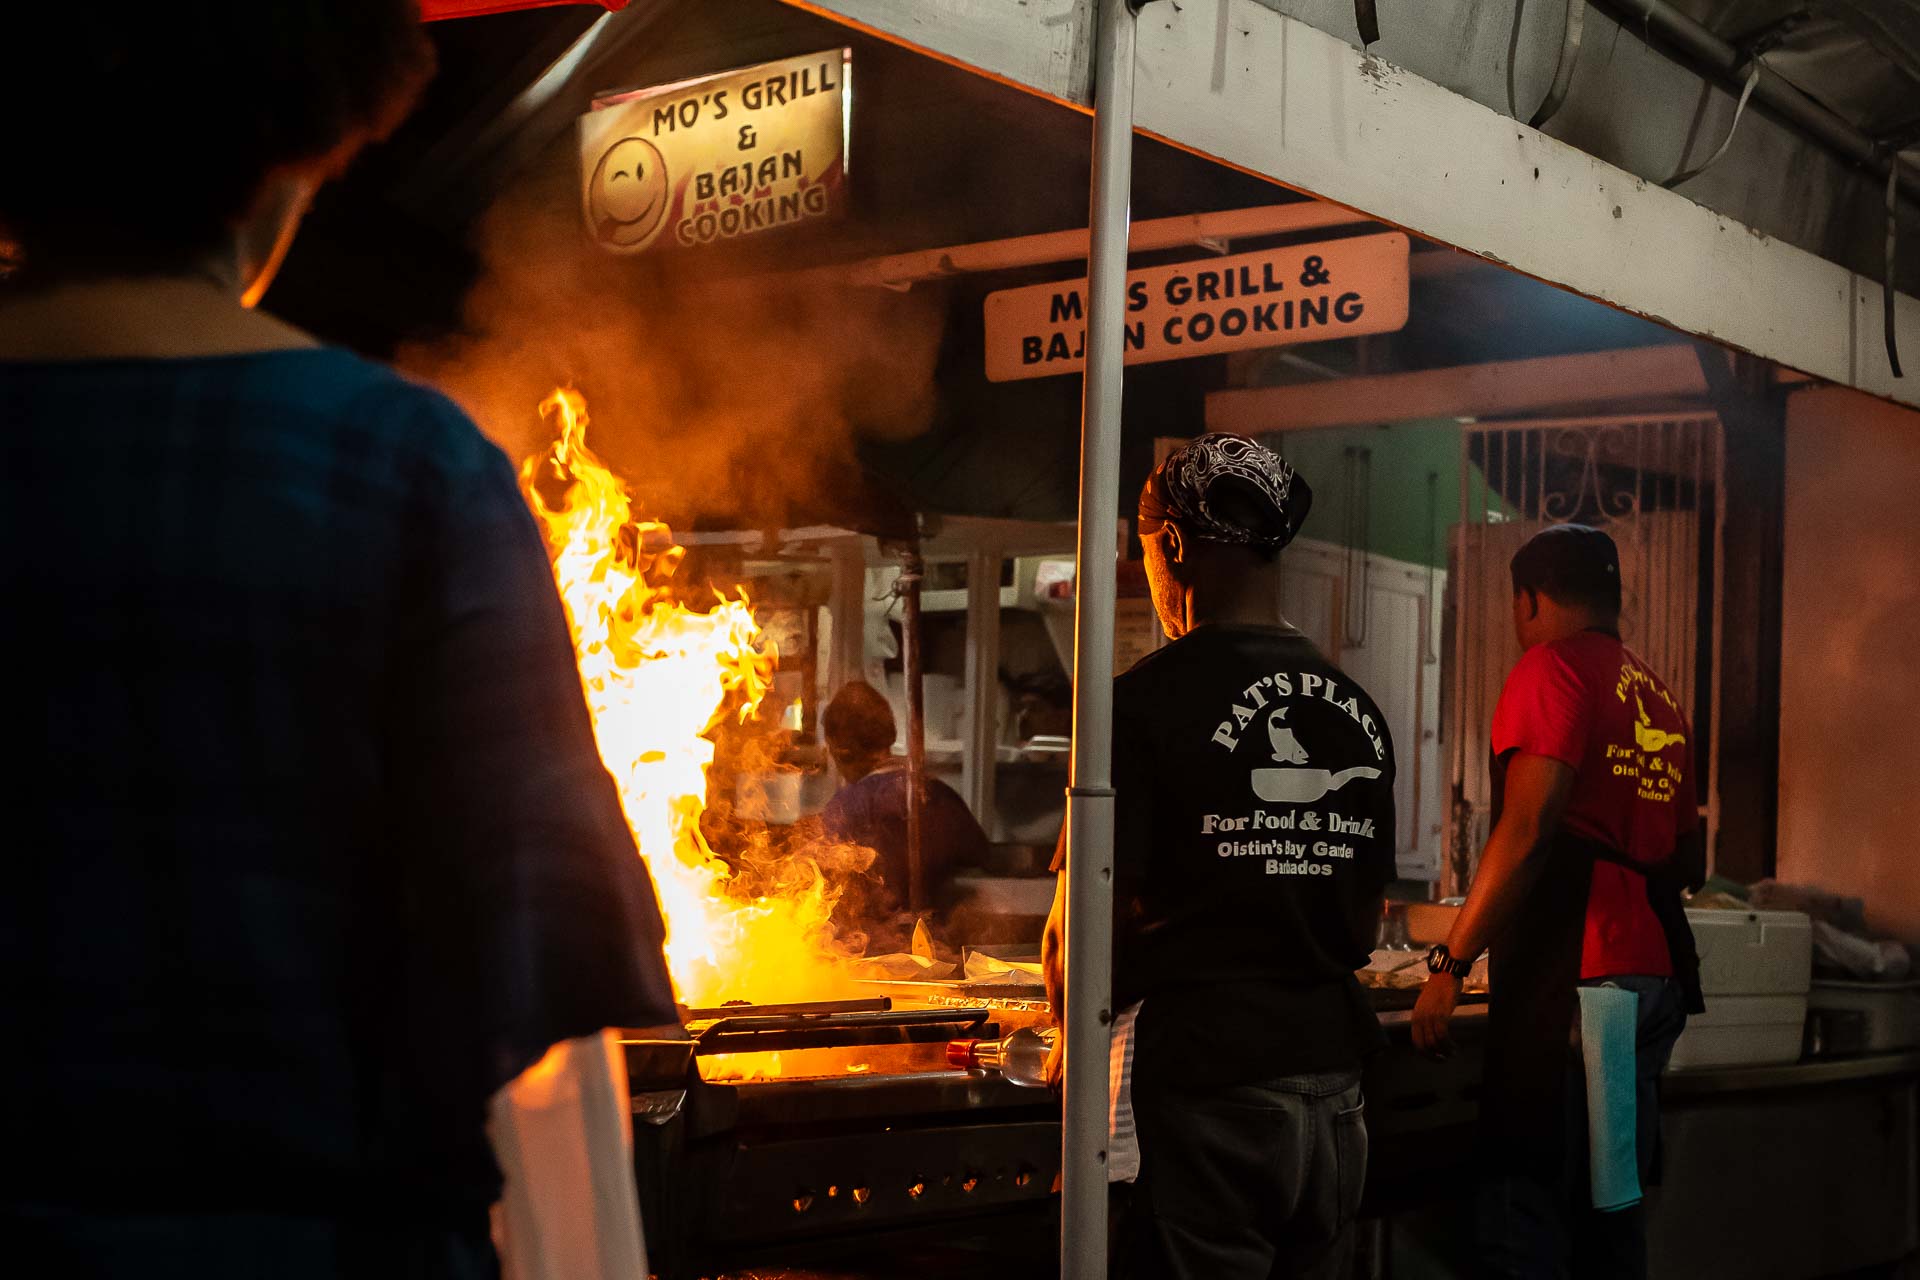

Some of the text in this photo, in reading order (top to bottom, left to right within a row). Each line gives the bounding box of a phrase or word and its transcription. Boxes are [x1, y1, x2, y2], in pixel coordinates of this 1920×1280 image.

[653, 64, 836, 136] MO'S GRILL
[738, 125, 757, 151] &
[695, 150, 803, 200] BAJAN
[678, 186, 826, 246] COOKING
[1050, 255, 1331, 323] MS GRILL &
[1022, 292, 1365, 365] BAJN COOKING
[1211, 672, 1385, 761] PAT'S PLACE
[1606, 744, 1635, 758] For
[1649, 757, 1663, 771] &
[1201, 809, 1376, 839] For Food & Drink
[1217, 839, 1283, 858] Oistin's
